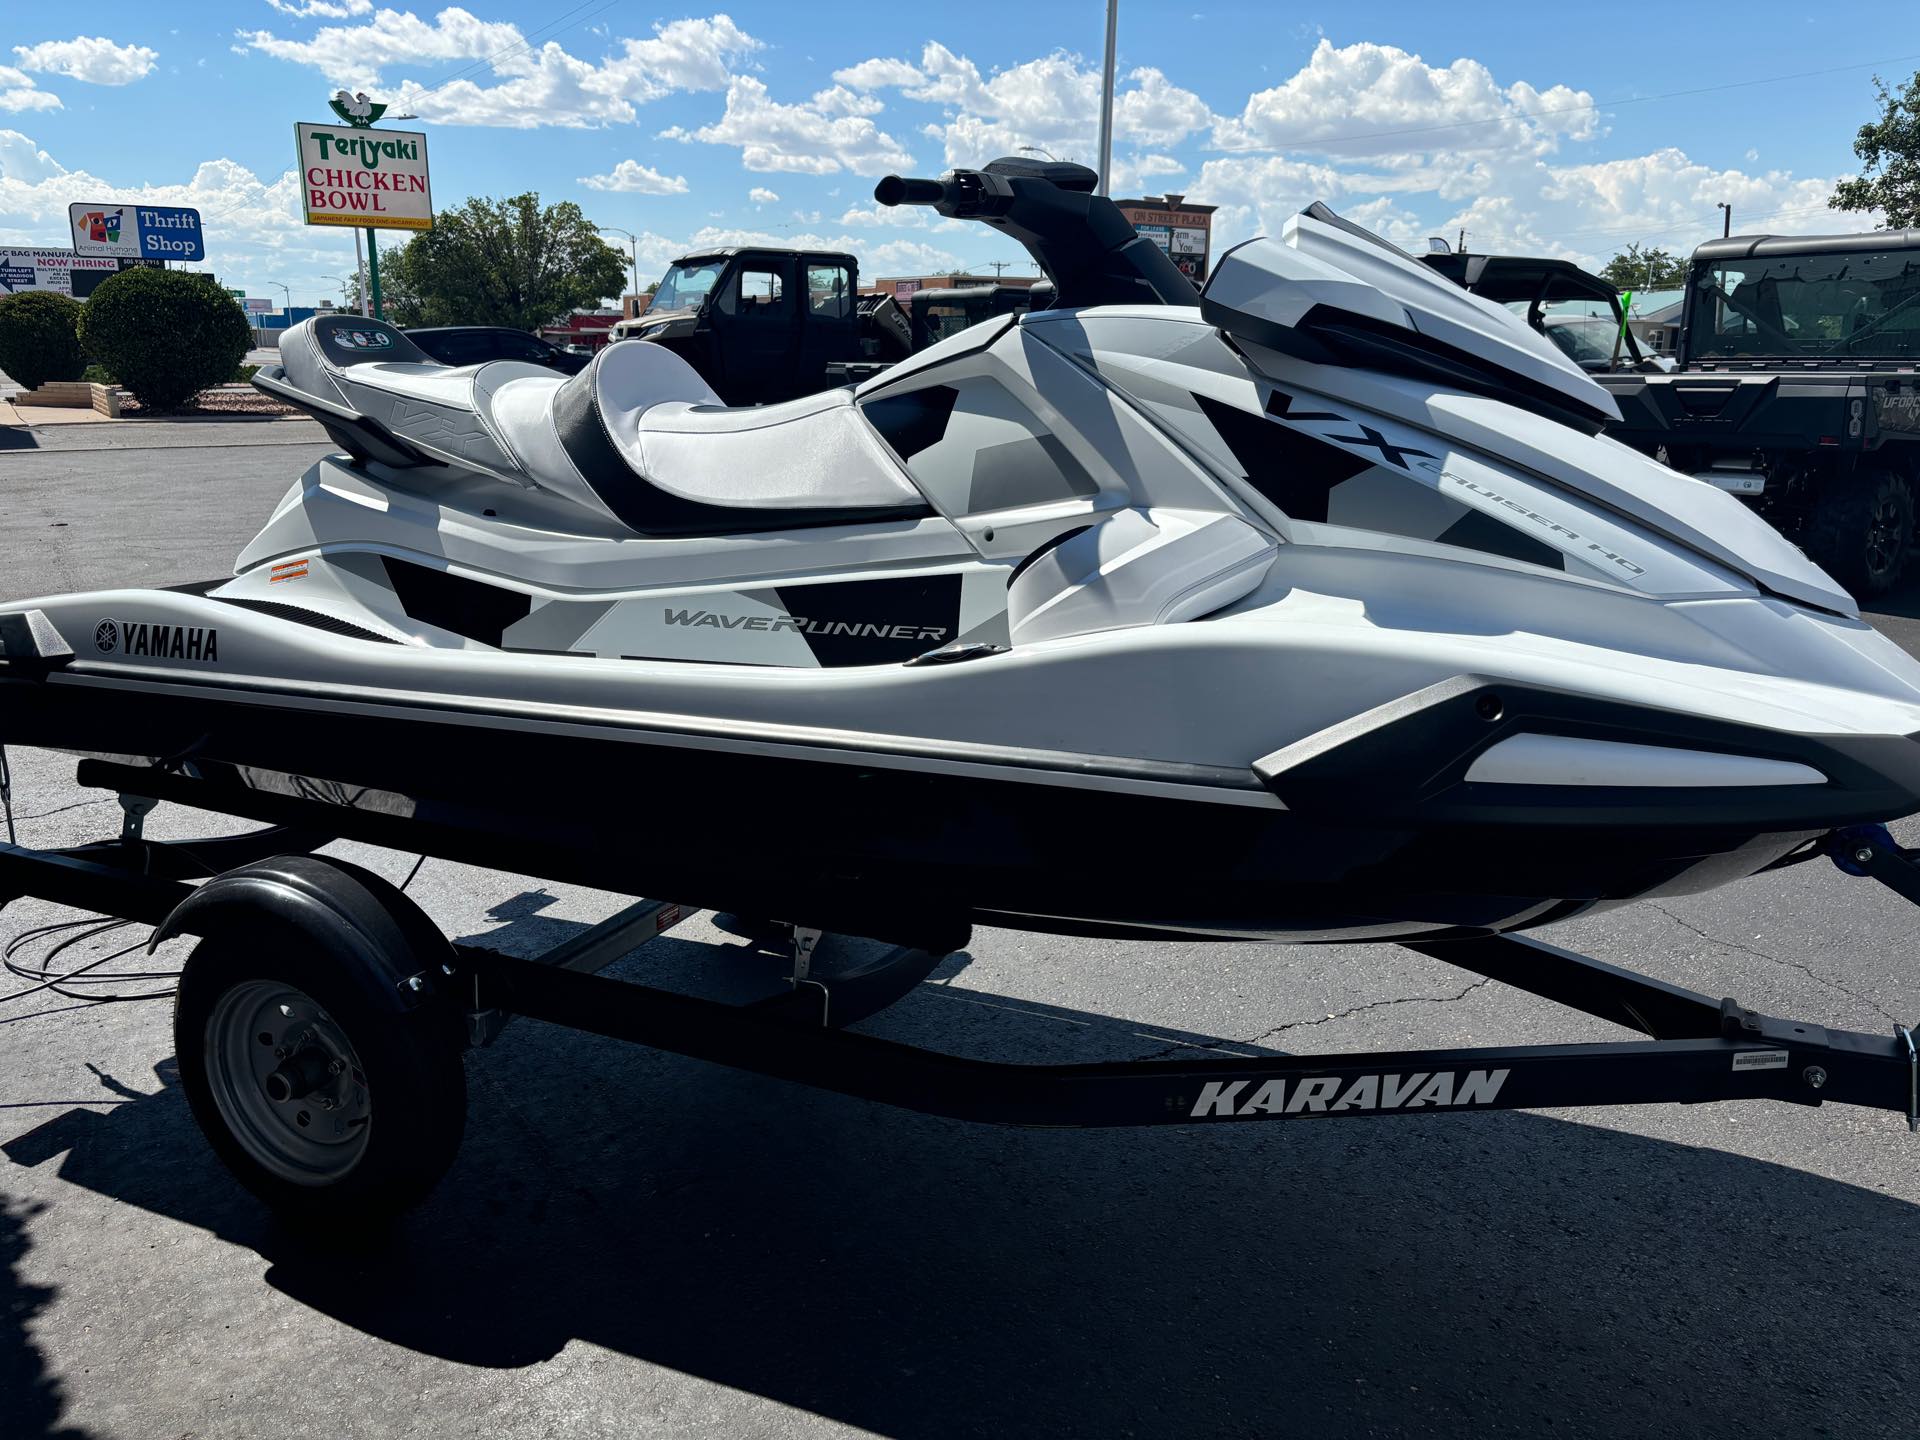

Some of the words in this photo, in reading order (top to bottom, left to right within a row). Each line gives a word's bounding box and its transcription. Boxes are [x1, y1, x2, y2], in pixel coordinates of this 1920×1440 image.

[310, 132, 418, 169] Teriyaki
[307, 168, 425, 193] CHICKEN
[309, 189, 386, 211] BOWL
[140, 211, 195, 229] Thrift
[1147, 212, 1180, 224] STREET
[1181, 214, 1207, 225] PLAZA
[106, 245, 137, 253] Humane
[147, 234, 196, 255] Shop
[1179, 242, 1193, 253] You
[37, 259, 69, 267] NOW
[72, 259, 116, 268] HIRING
[389, 399, 490, 455] VX
[1265, 388, 1442, 471] VX
[1416, 460, 1580, 541] CRUISER
[1587, 543, 1646, 576] HO
[664, 608, 947, 641] WAVERUNNER
[122, 622, 218, 662] YAMAHA
[1189, 1068, 1511, 1117] KARAVAN
